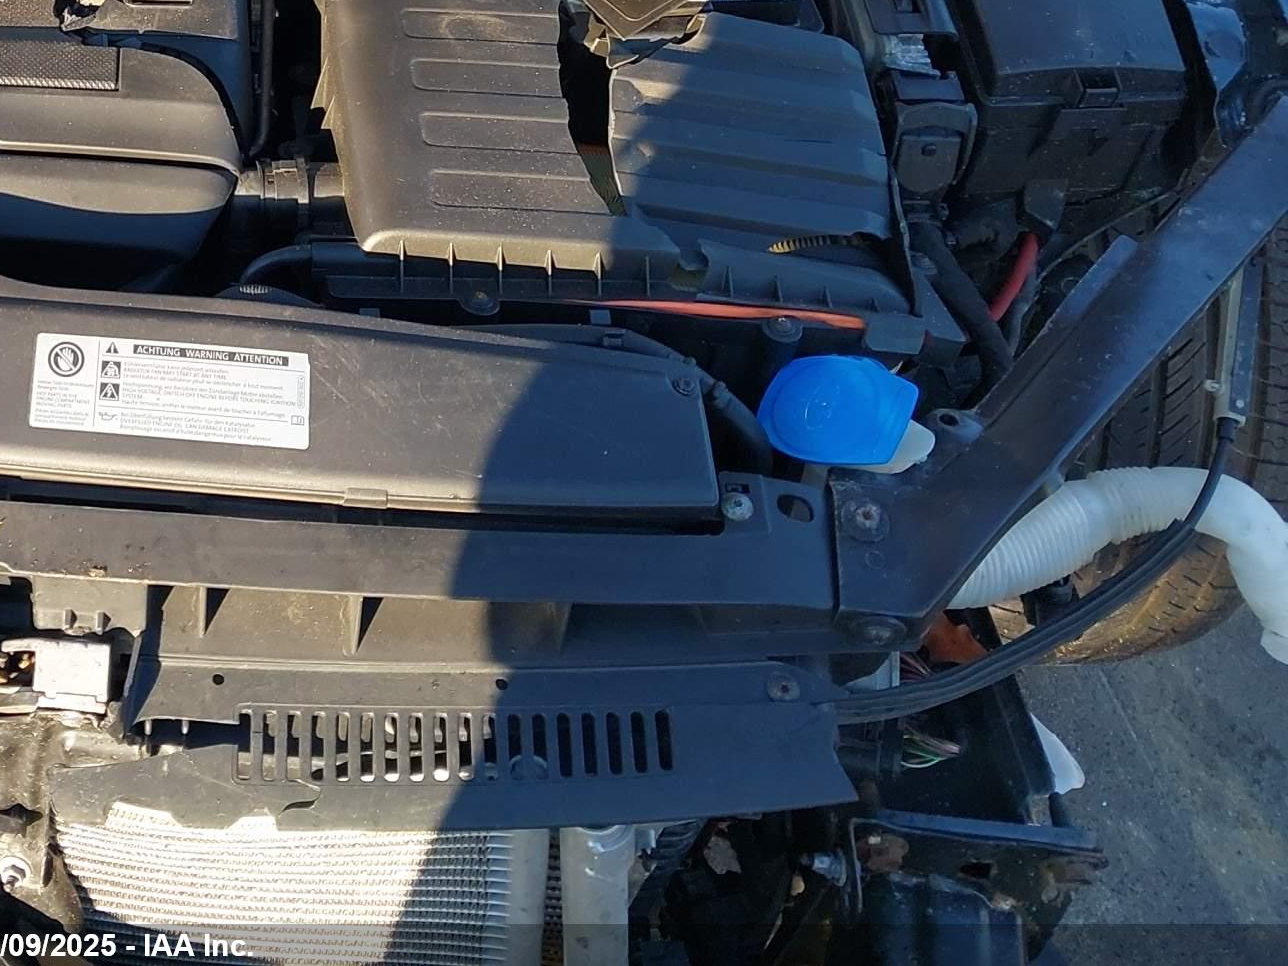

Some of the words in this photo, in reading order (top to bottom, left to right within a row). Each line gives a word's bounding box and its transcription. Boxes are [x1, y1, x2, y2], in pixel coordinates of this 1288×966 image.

[137, 346, 180, 356] ACHTUNG
[186, 350, 228, 360] WARNING
[234, 354, 282, 365] ATTENTION
